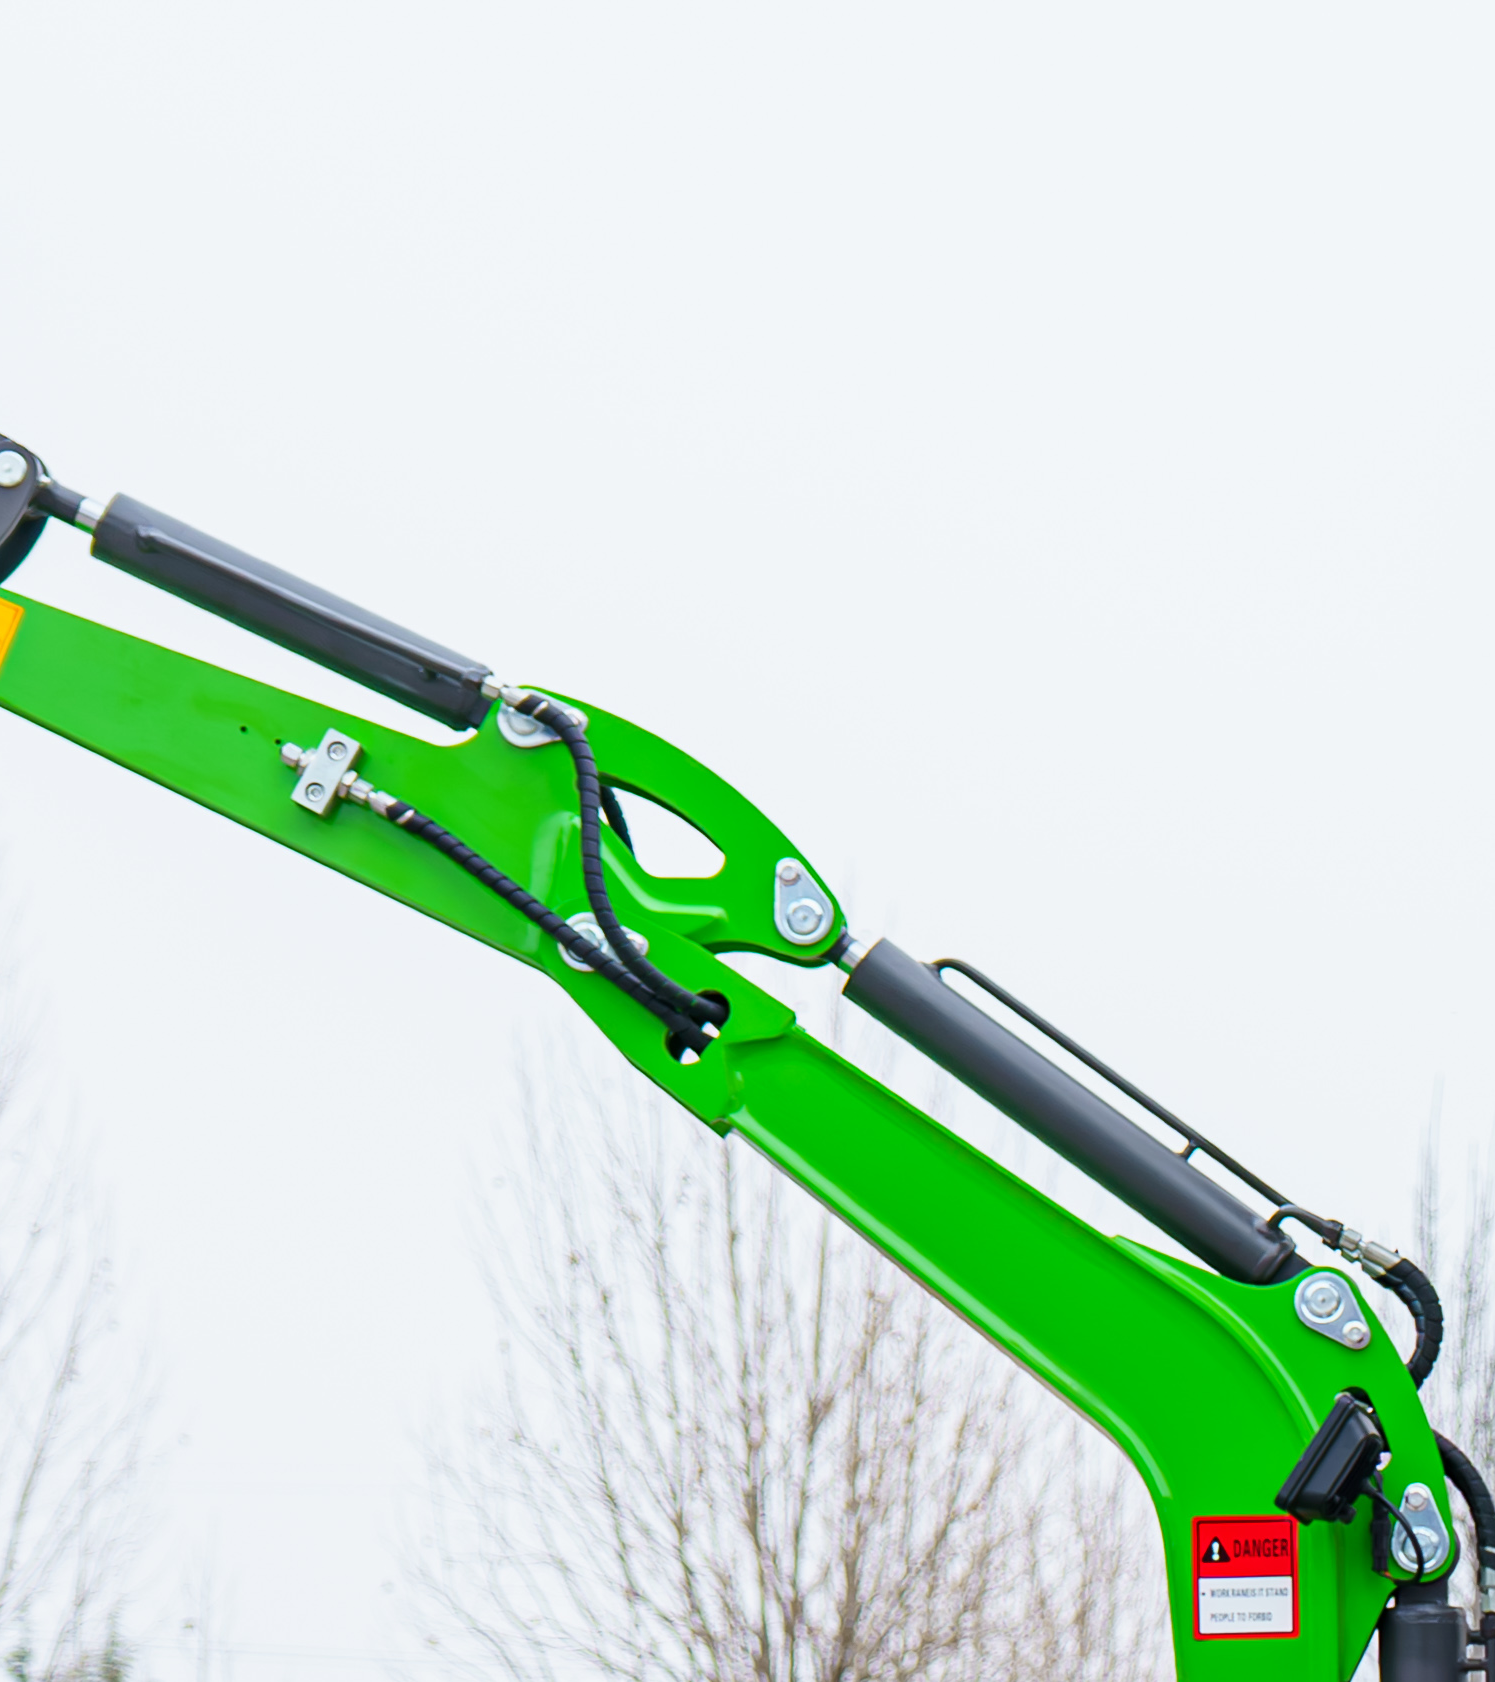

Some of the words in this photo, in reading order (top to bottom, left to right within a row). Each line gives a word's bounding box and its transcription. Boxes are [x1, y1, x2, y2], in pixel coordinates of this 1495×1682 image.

[1233, 1538, 1289, 1558] DANGER
[1210, 1612, 1234, 1622] PEOPLE
[1237, 1612, 1246, 1622] TO
